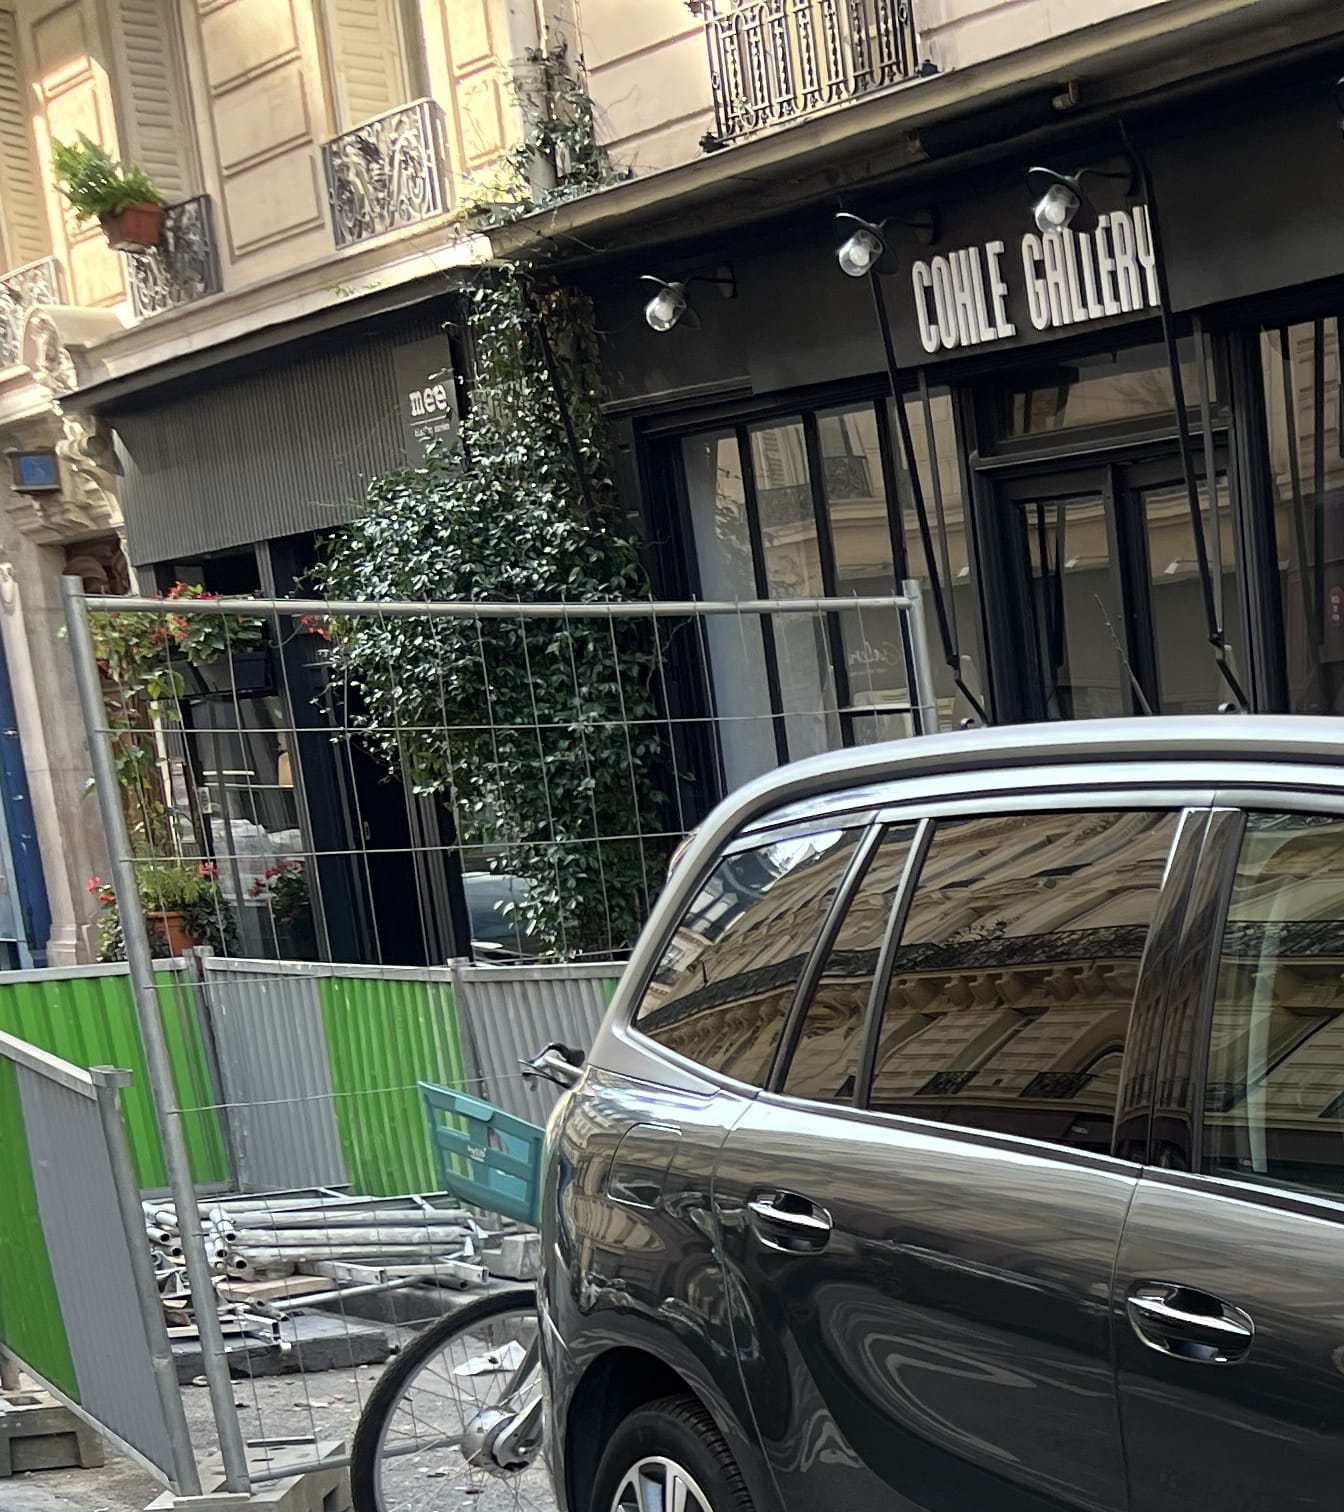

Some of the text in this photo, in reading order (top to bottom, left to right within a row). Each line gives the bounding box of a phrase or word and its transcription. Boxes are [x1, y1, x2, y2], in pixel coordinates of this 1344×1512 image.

[911, 204, 1161, 353] COHLE GALLERY
[408, 384, 448, 417] mee
